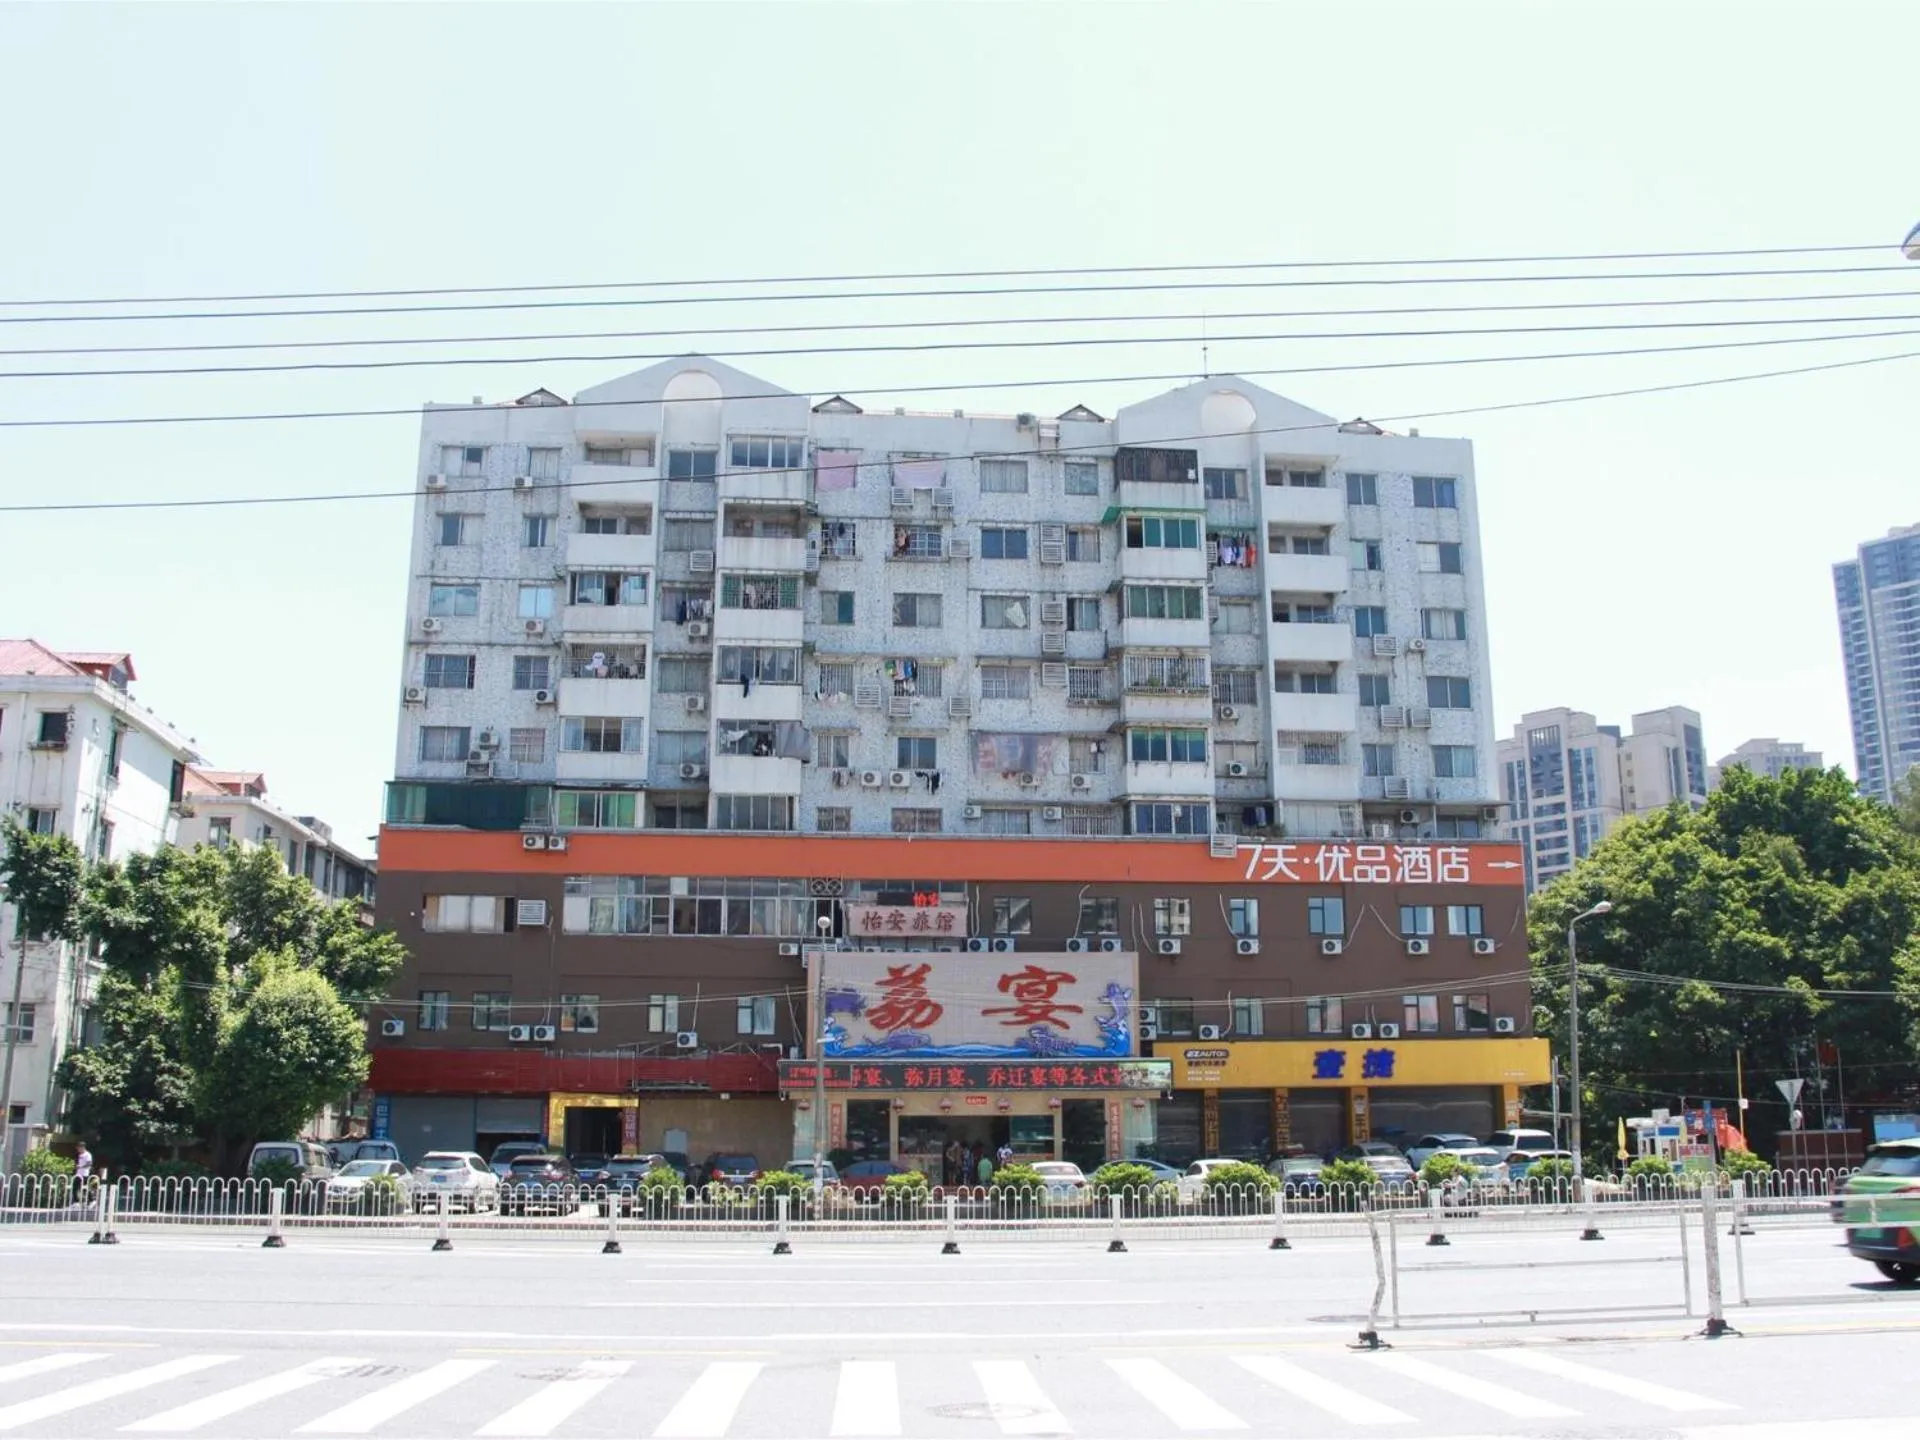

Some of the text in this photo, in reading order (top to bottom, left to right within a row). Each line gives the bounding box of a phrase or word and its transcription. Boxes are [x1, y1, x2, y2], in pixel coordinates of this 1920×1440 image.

[1236, 844, 1470, 883] 7天·优品酒店
[861, 908, 956, 933] 怡安旅馆
